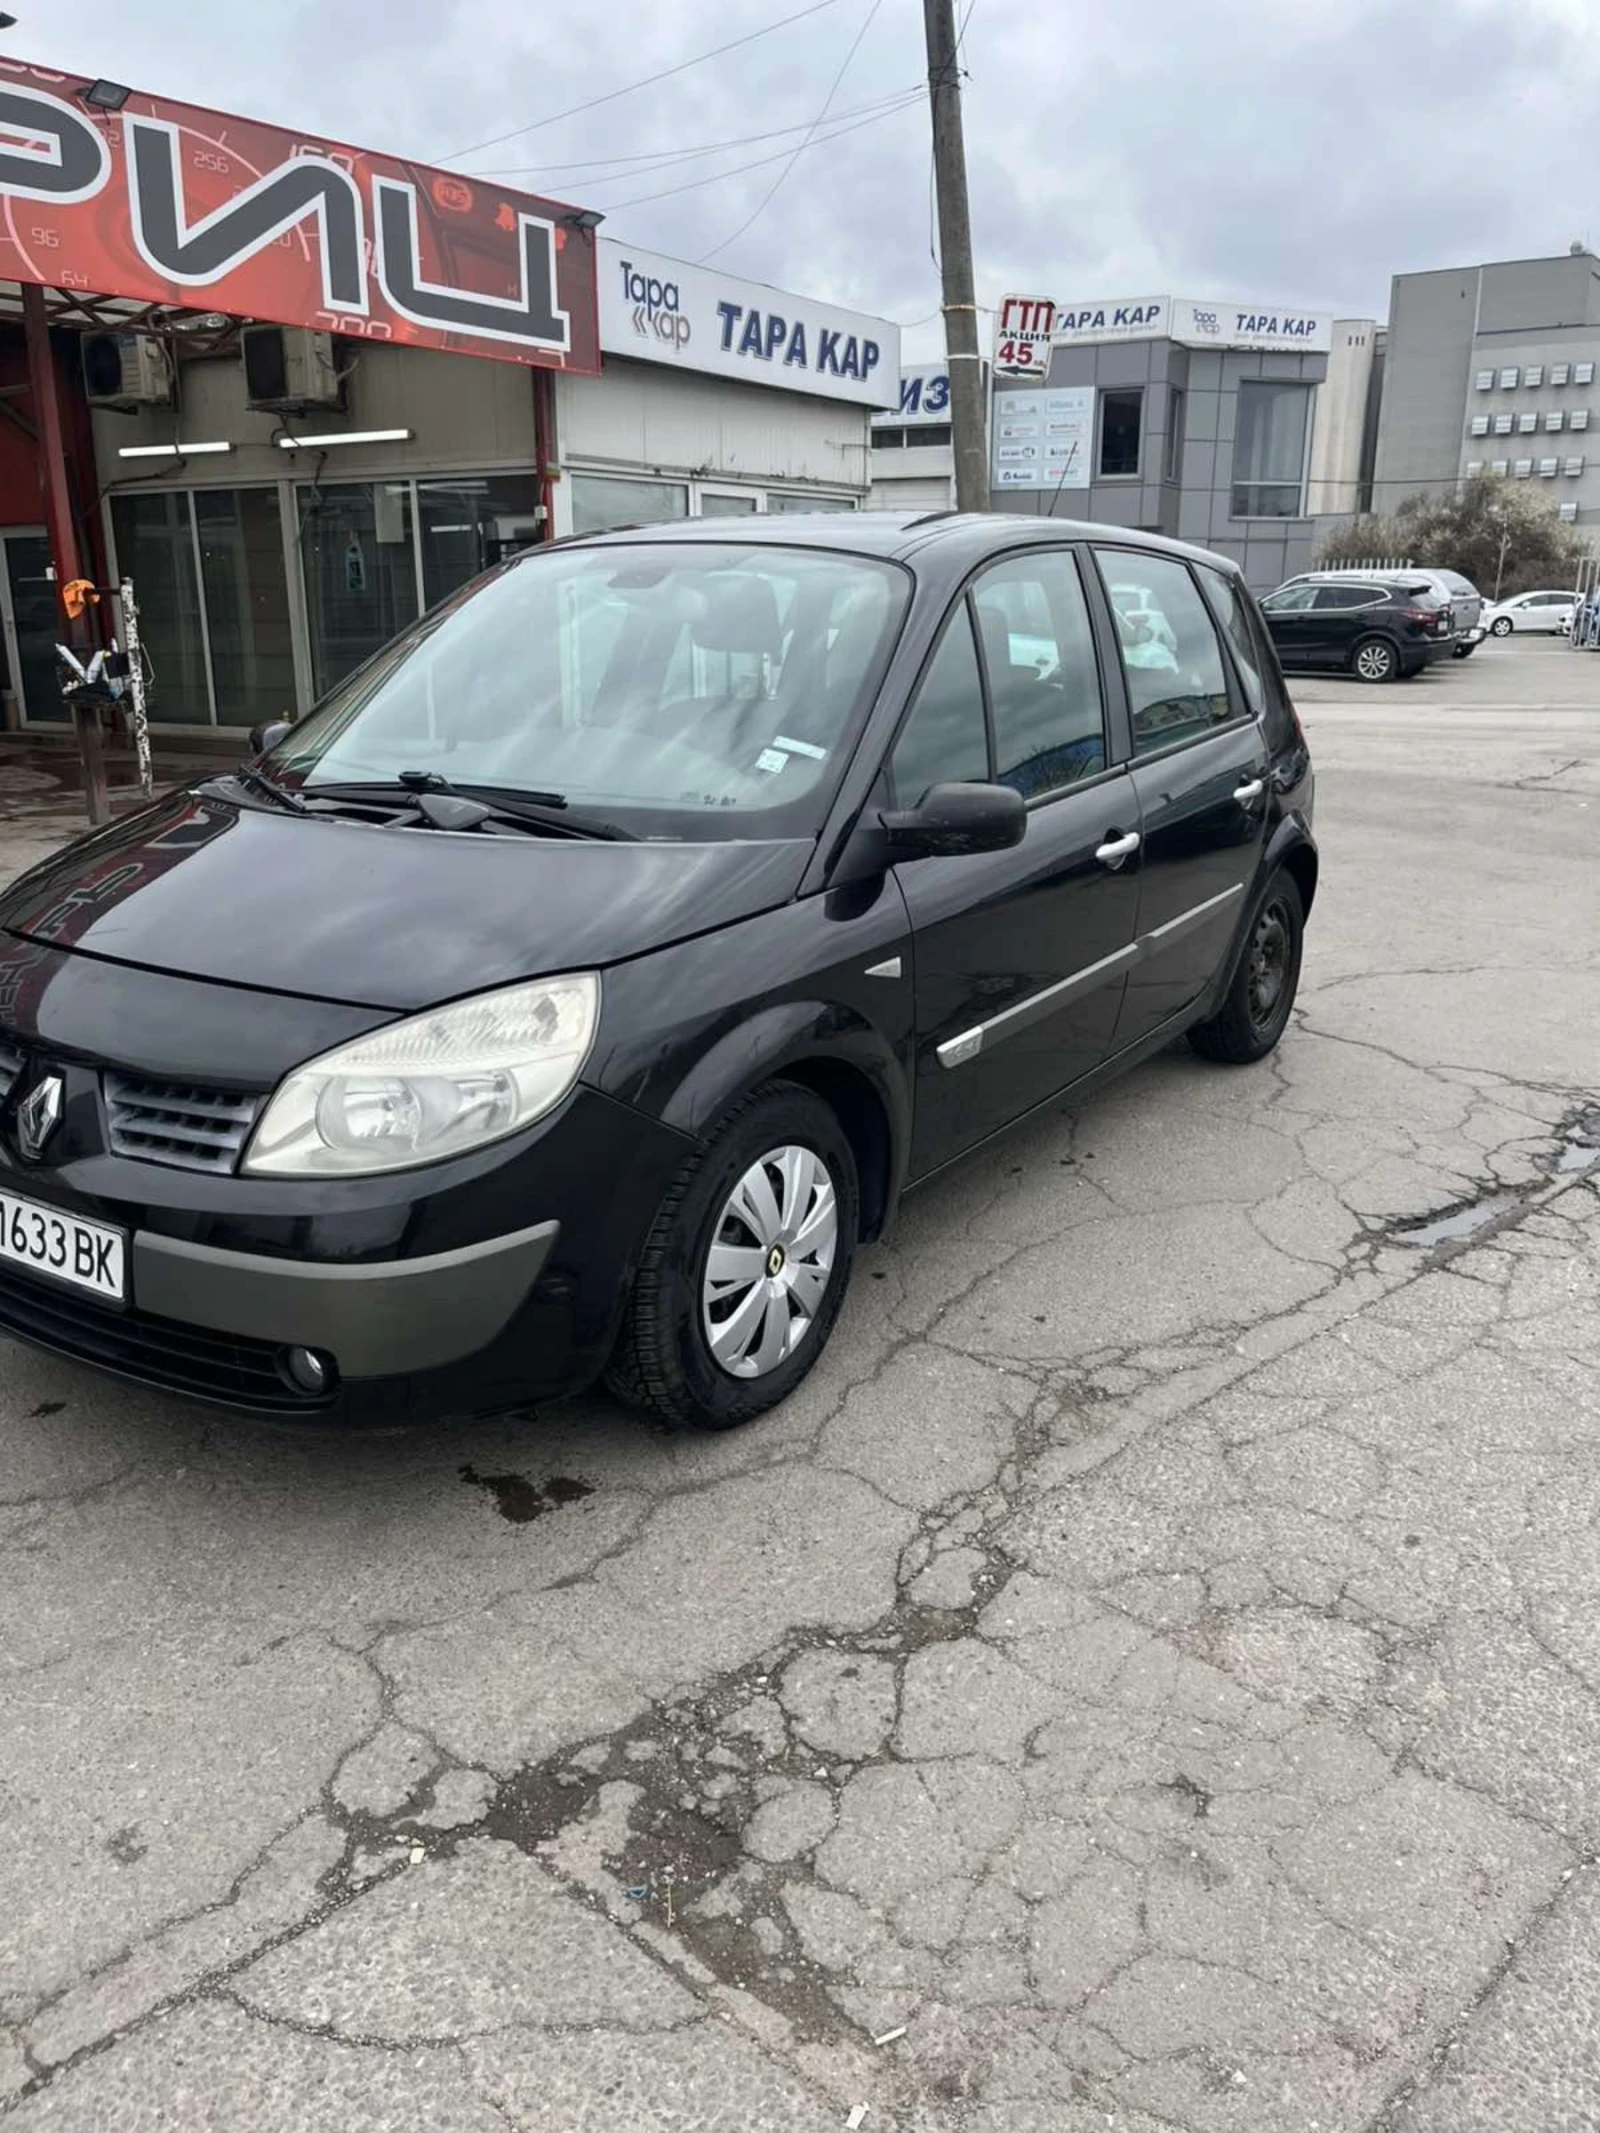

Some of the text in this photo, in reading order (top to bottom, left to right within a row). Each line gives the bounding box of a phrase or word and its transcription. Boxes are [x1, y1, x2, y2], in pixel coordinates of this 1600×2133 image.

[619, 260, 680, 322] Тара
[1001, 299, 1055, 333] ГТП
[1113, 305, 1160, 326] КАР
[1236, 313, 1316, 337] ТАРА КАР
[717, 300, 880, 382] ТАРА КАР
[999, 330, 1050, 342] АКЦИЯ
[999, 340, 1033, 365] 45
